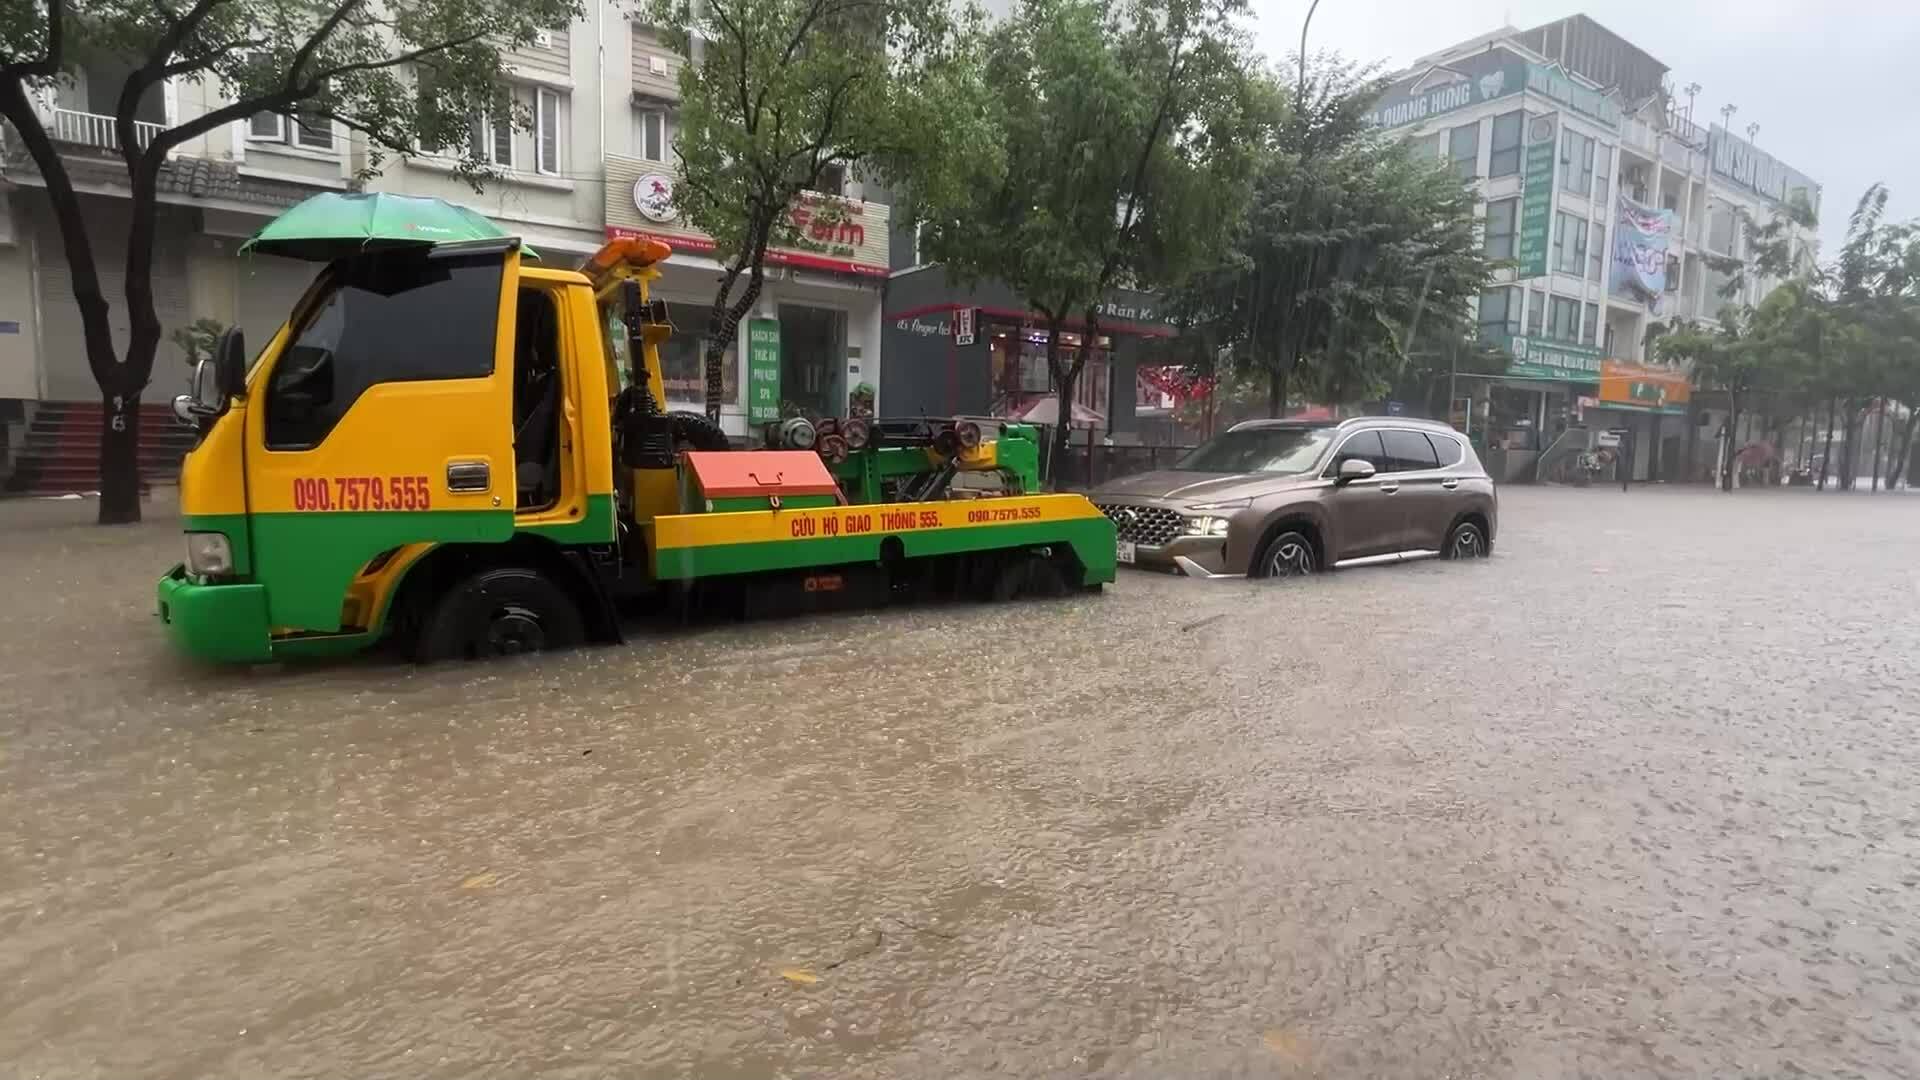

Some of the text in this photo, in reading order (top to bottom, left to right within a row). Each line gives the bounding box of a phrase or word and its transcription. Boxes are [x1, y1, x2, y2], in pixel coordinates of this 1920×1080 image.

[1384, 96, 1427, 128] QUANG
[294, 476, 431, 511] 090.7579.555
[823, 512, 839, 537] HỘ
[845, 514, 871, 533] GIAO
[880, 509, 916, 531] THÔNG
[968, 506, 1041, 523] 090.7579.555
